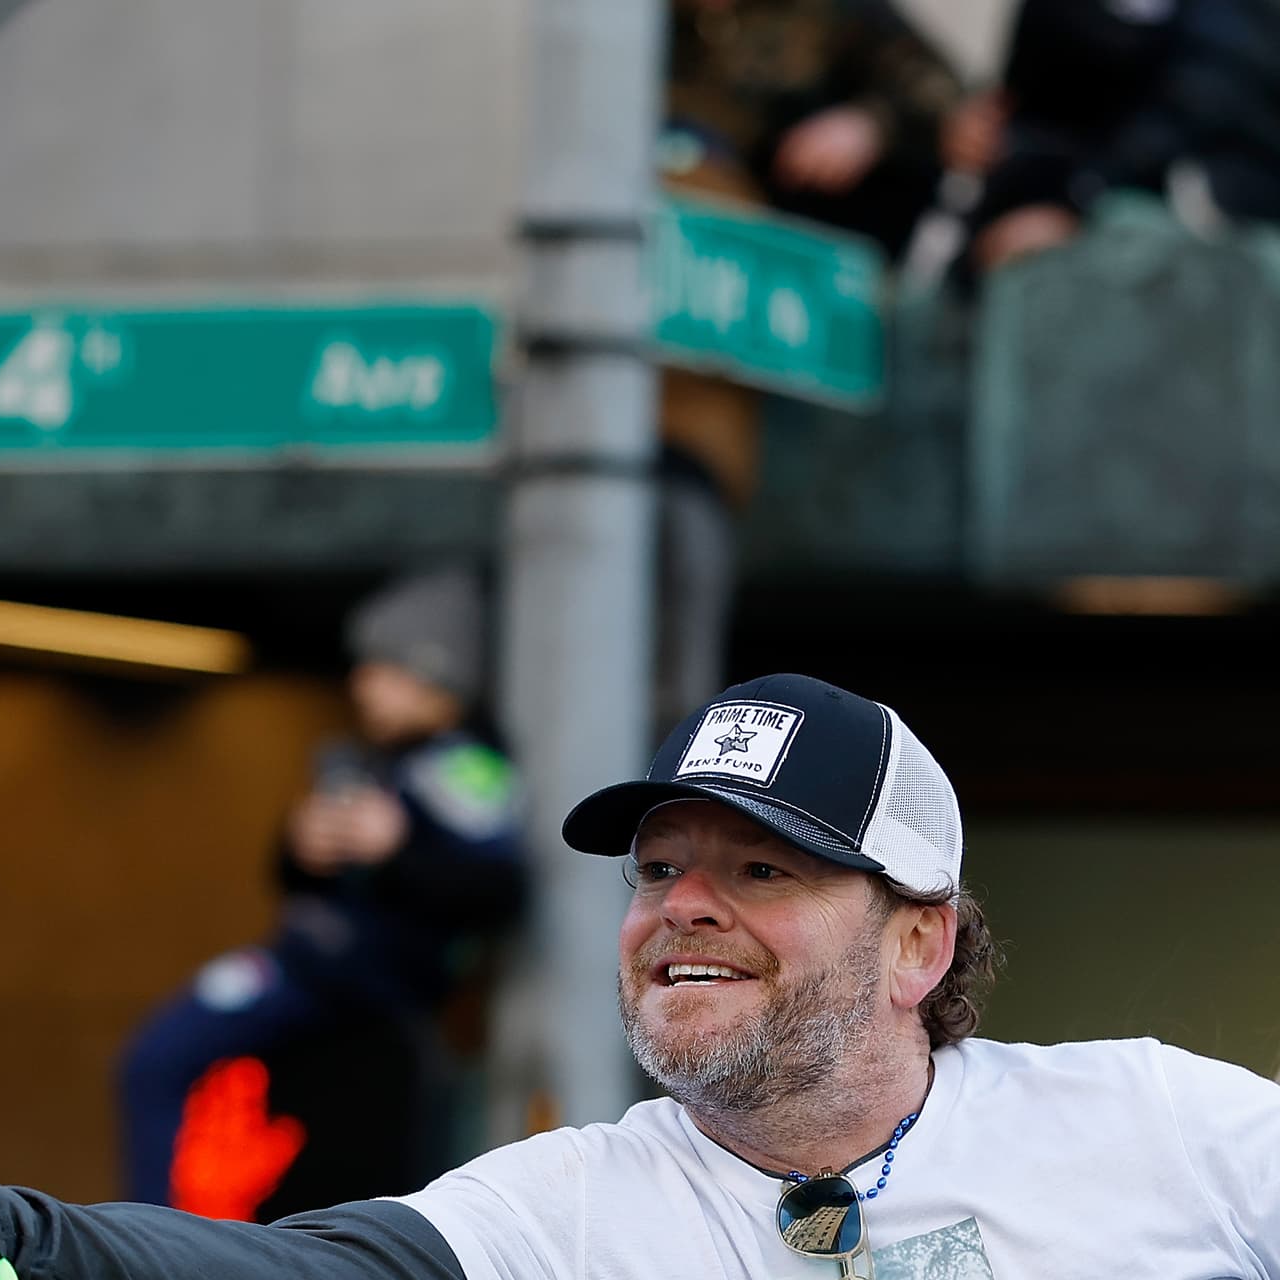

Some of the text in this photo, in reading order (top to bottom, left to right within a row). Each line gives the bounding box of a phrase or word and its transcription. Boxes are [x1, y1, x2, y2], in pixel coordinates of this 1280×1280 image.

[707, 708, 789, 730] PRIME TIME
[686, 757, 762, 772] BEN'S FUND
